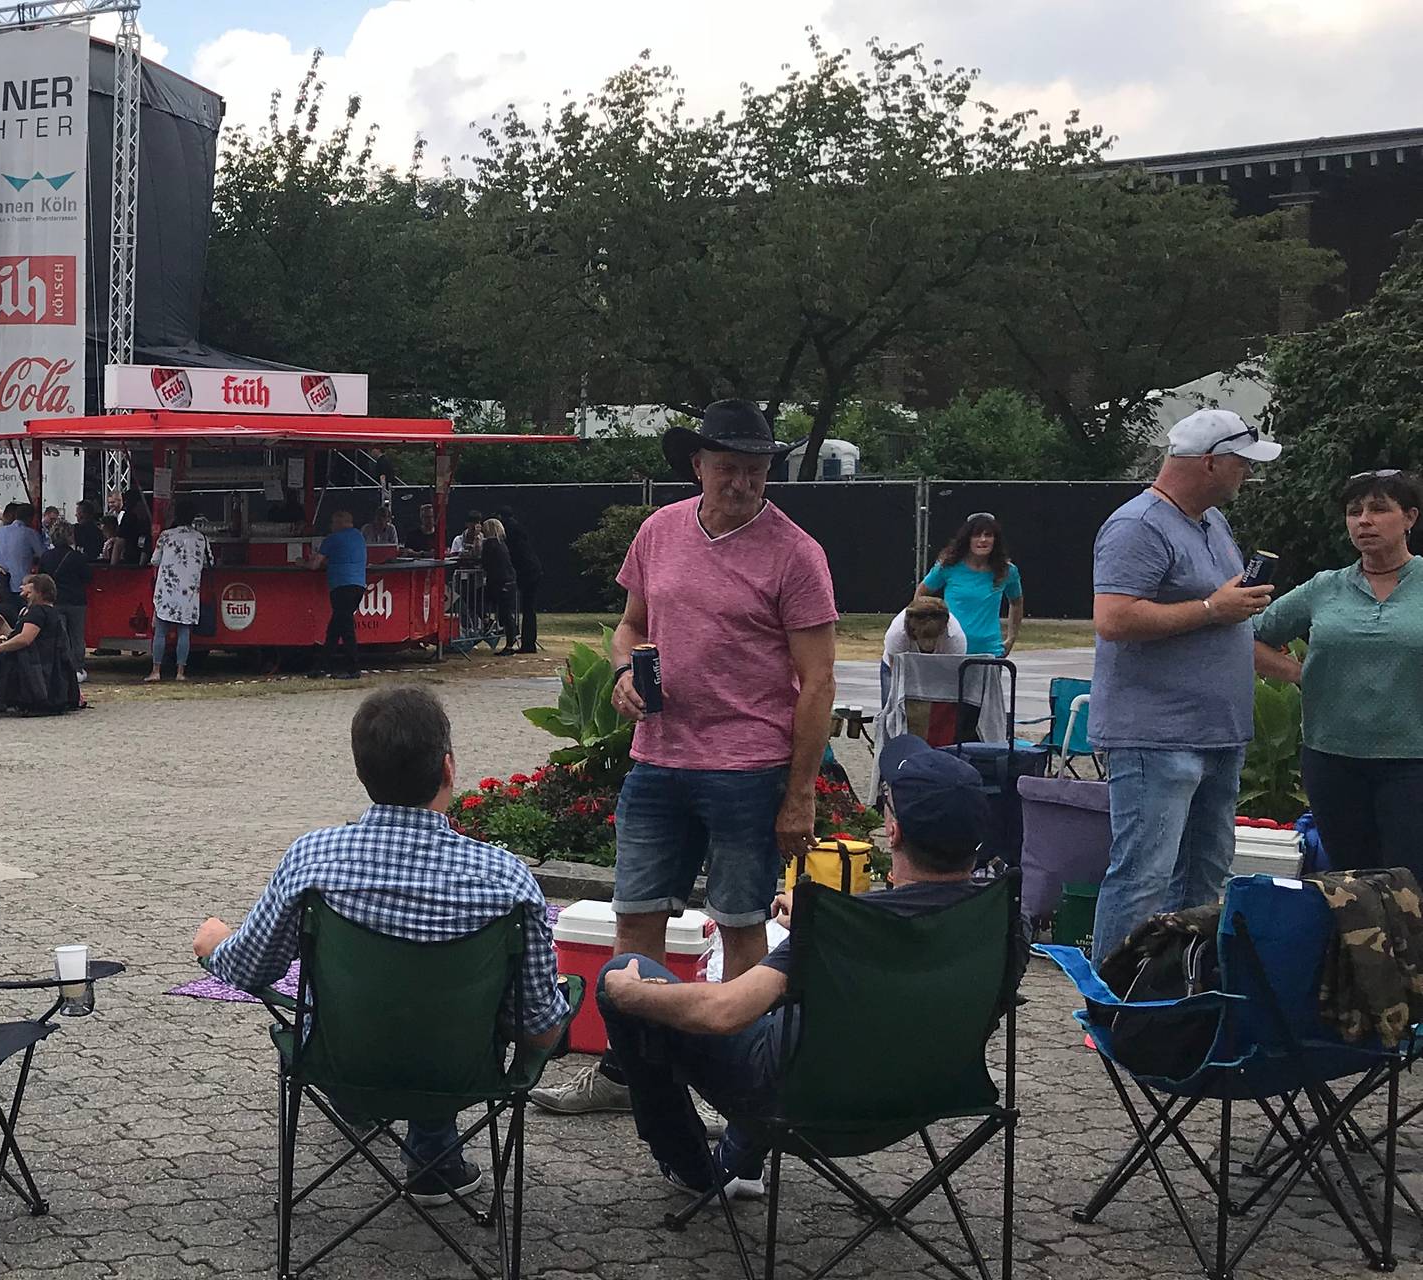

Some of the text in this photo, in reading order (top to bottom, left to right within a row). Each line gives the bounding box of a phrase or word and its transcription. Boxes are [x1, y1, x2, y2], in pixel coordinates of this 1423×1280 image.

[41, 196, 77, 213] Köln
[52, 263, 65, 317] KÖLSCH
[161, 377, 186, 401] früh
[221, 375, 270, 409] früh
[226, 603, 251, 616] früh
[353, 579, 392, 620] üh
